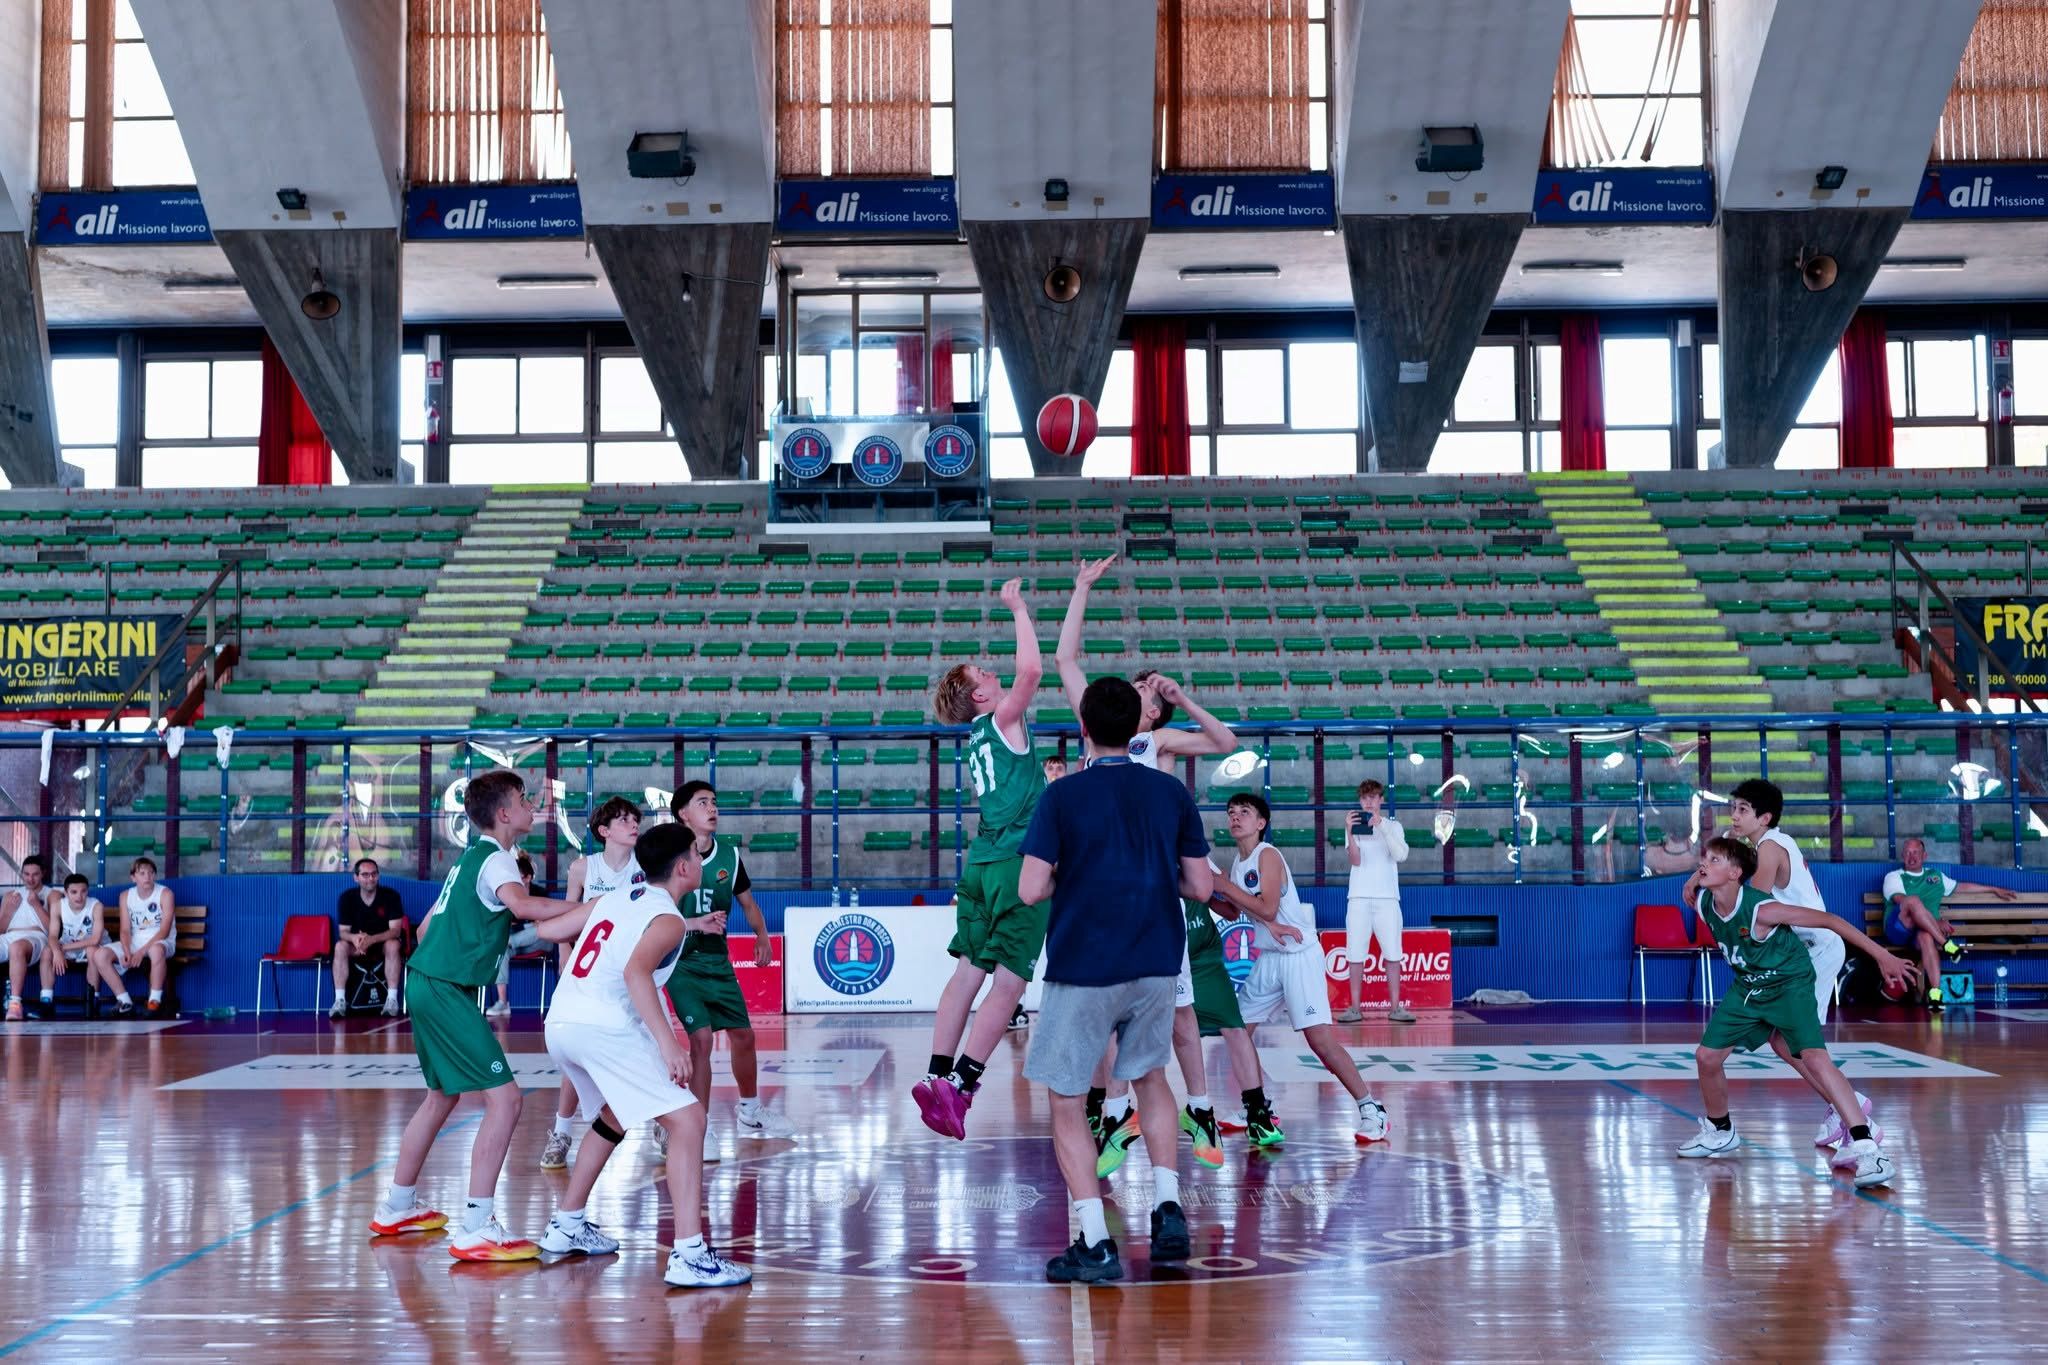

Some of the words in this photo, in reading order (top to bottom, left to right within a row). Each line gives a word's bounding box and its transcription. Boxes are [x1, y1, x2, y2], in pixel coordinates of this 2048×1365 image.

[816, 192, 860, 222] ali
[860, 211, 909, 222] Missione
[913, 211, 951, 222] lavoro.
[1190, 185, 1235, 216] ali
[1235, 205, 1285, 216] Missione
[1289, 205, 1327, 215] lavoro.
[1568, 181, 1613, 211] ali
[1613, 201, 1663, 212] Missione
[1667, 200, 1706, 211] lavoro.
[1949, 176, 1993, 208] ali
[1994, 196, 2045, 206] Missione
[75, 204, 119, 235] ali
[119, 223, 167, 235] Missione
[444, 199, 488, 229] ali
[488, 218, 537, 229] Missione
[0, 621, 157, 660] NGERINI
[693, 888, 714, 914] 15
[572, 919, 615, 979] 6
[1420, 972, 1451, 981] Lavoro
